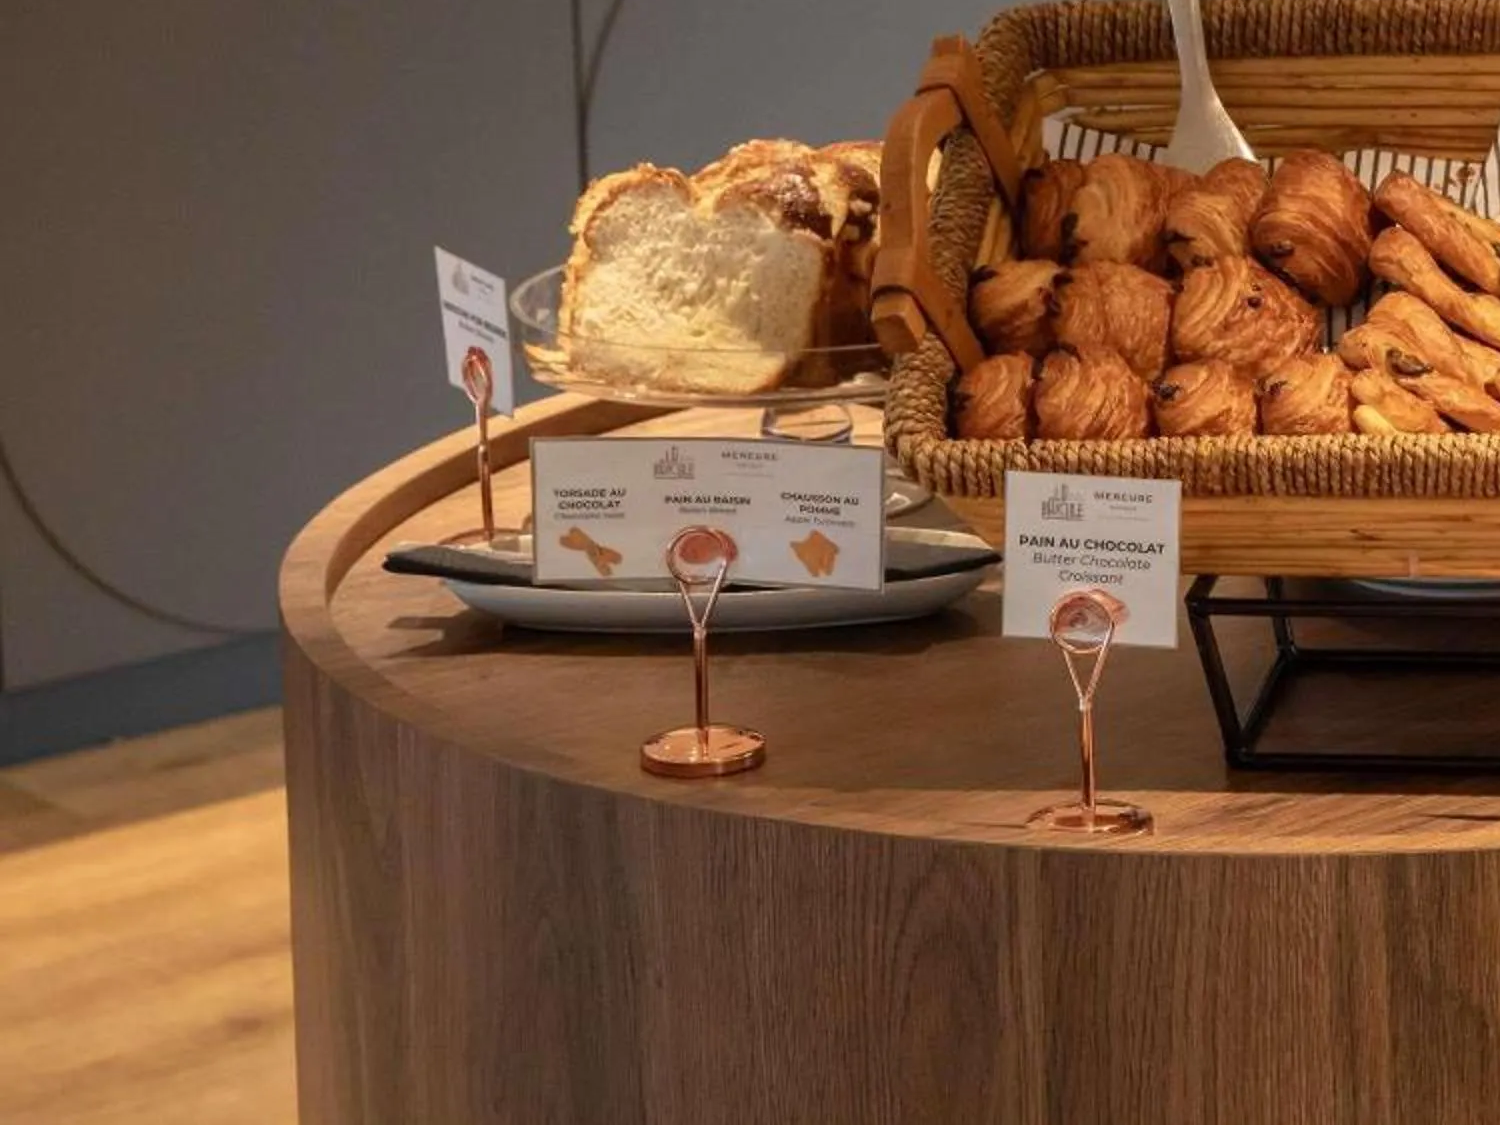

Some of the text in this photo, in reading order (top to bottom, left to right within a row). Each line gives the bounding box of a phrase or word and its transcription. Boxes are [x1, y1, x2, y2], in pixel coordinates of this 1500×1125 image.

[553, 487, 627, 498] TORSADE AU
[1094, 490, 1153, 504] MERCURE
[557, 500, 621, 510] CHOCOLAT
[664, 495, 751, 505] PAIN AU RAISIN
[843, 496, 860, 506] AU
[1019, 534, 1165, 555] PAIN AU CHOCOLAT
[1033, 552, 1151, 570] Butter Chocolate
[1058, 570, 1124, 585] Croissant
